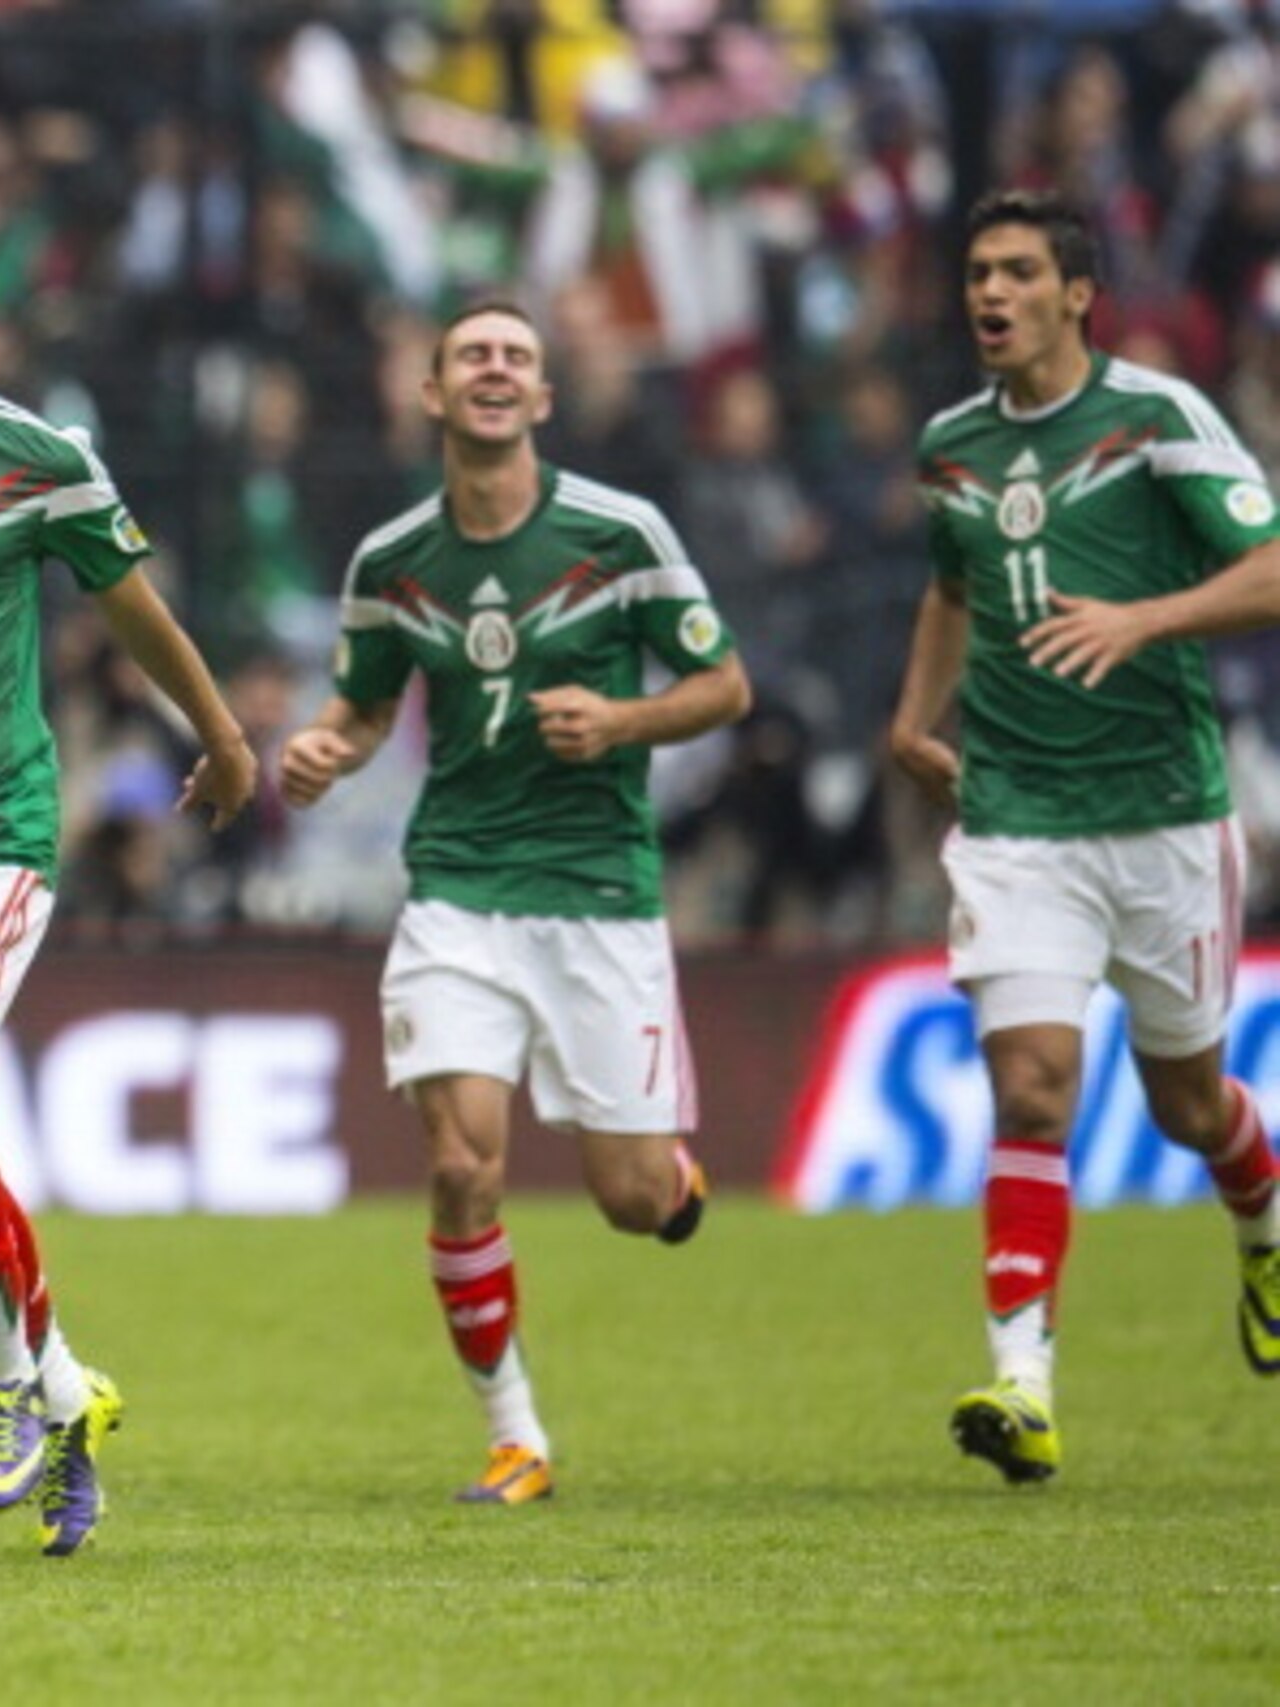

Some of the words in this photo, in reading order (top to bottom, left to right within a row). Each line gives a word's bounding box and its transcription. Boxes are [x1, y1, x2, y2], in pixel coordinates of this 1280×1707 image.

[1003, 545, 1051, 622] 11
[481, 678, 513, 747] 7
[641, 1024, 662, 1097] 7
